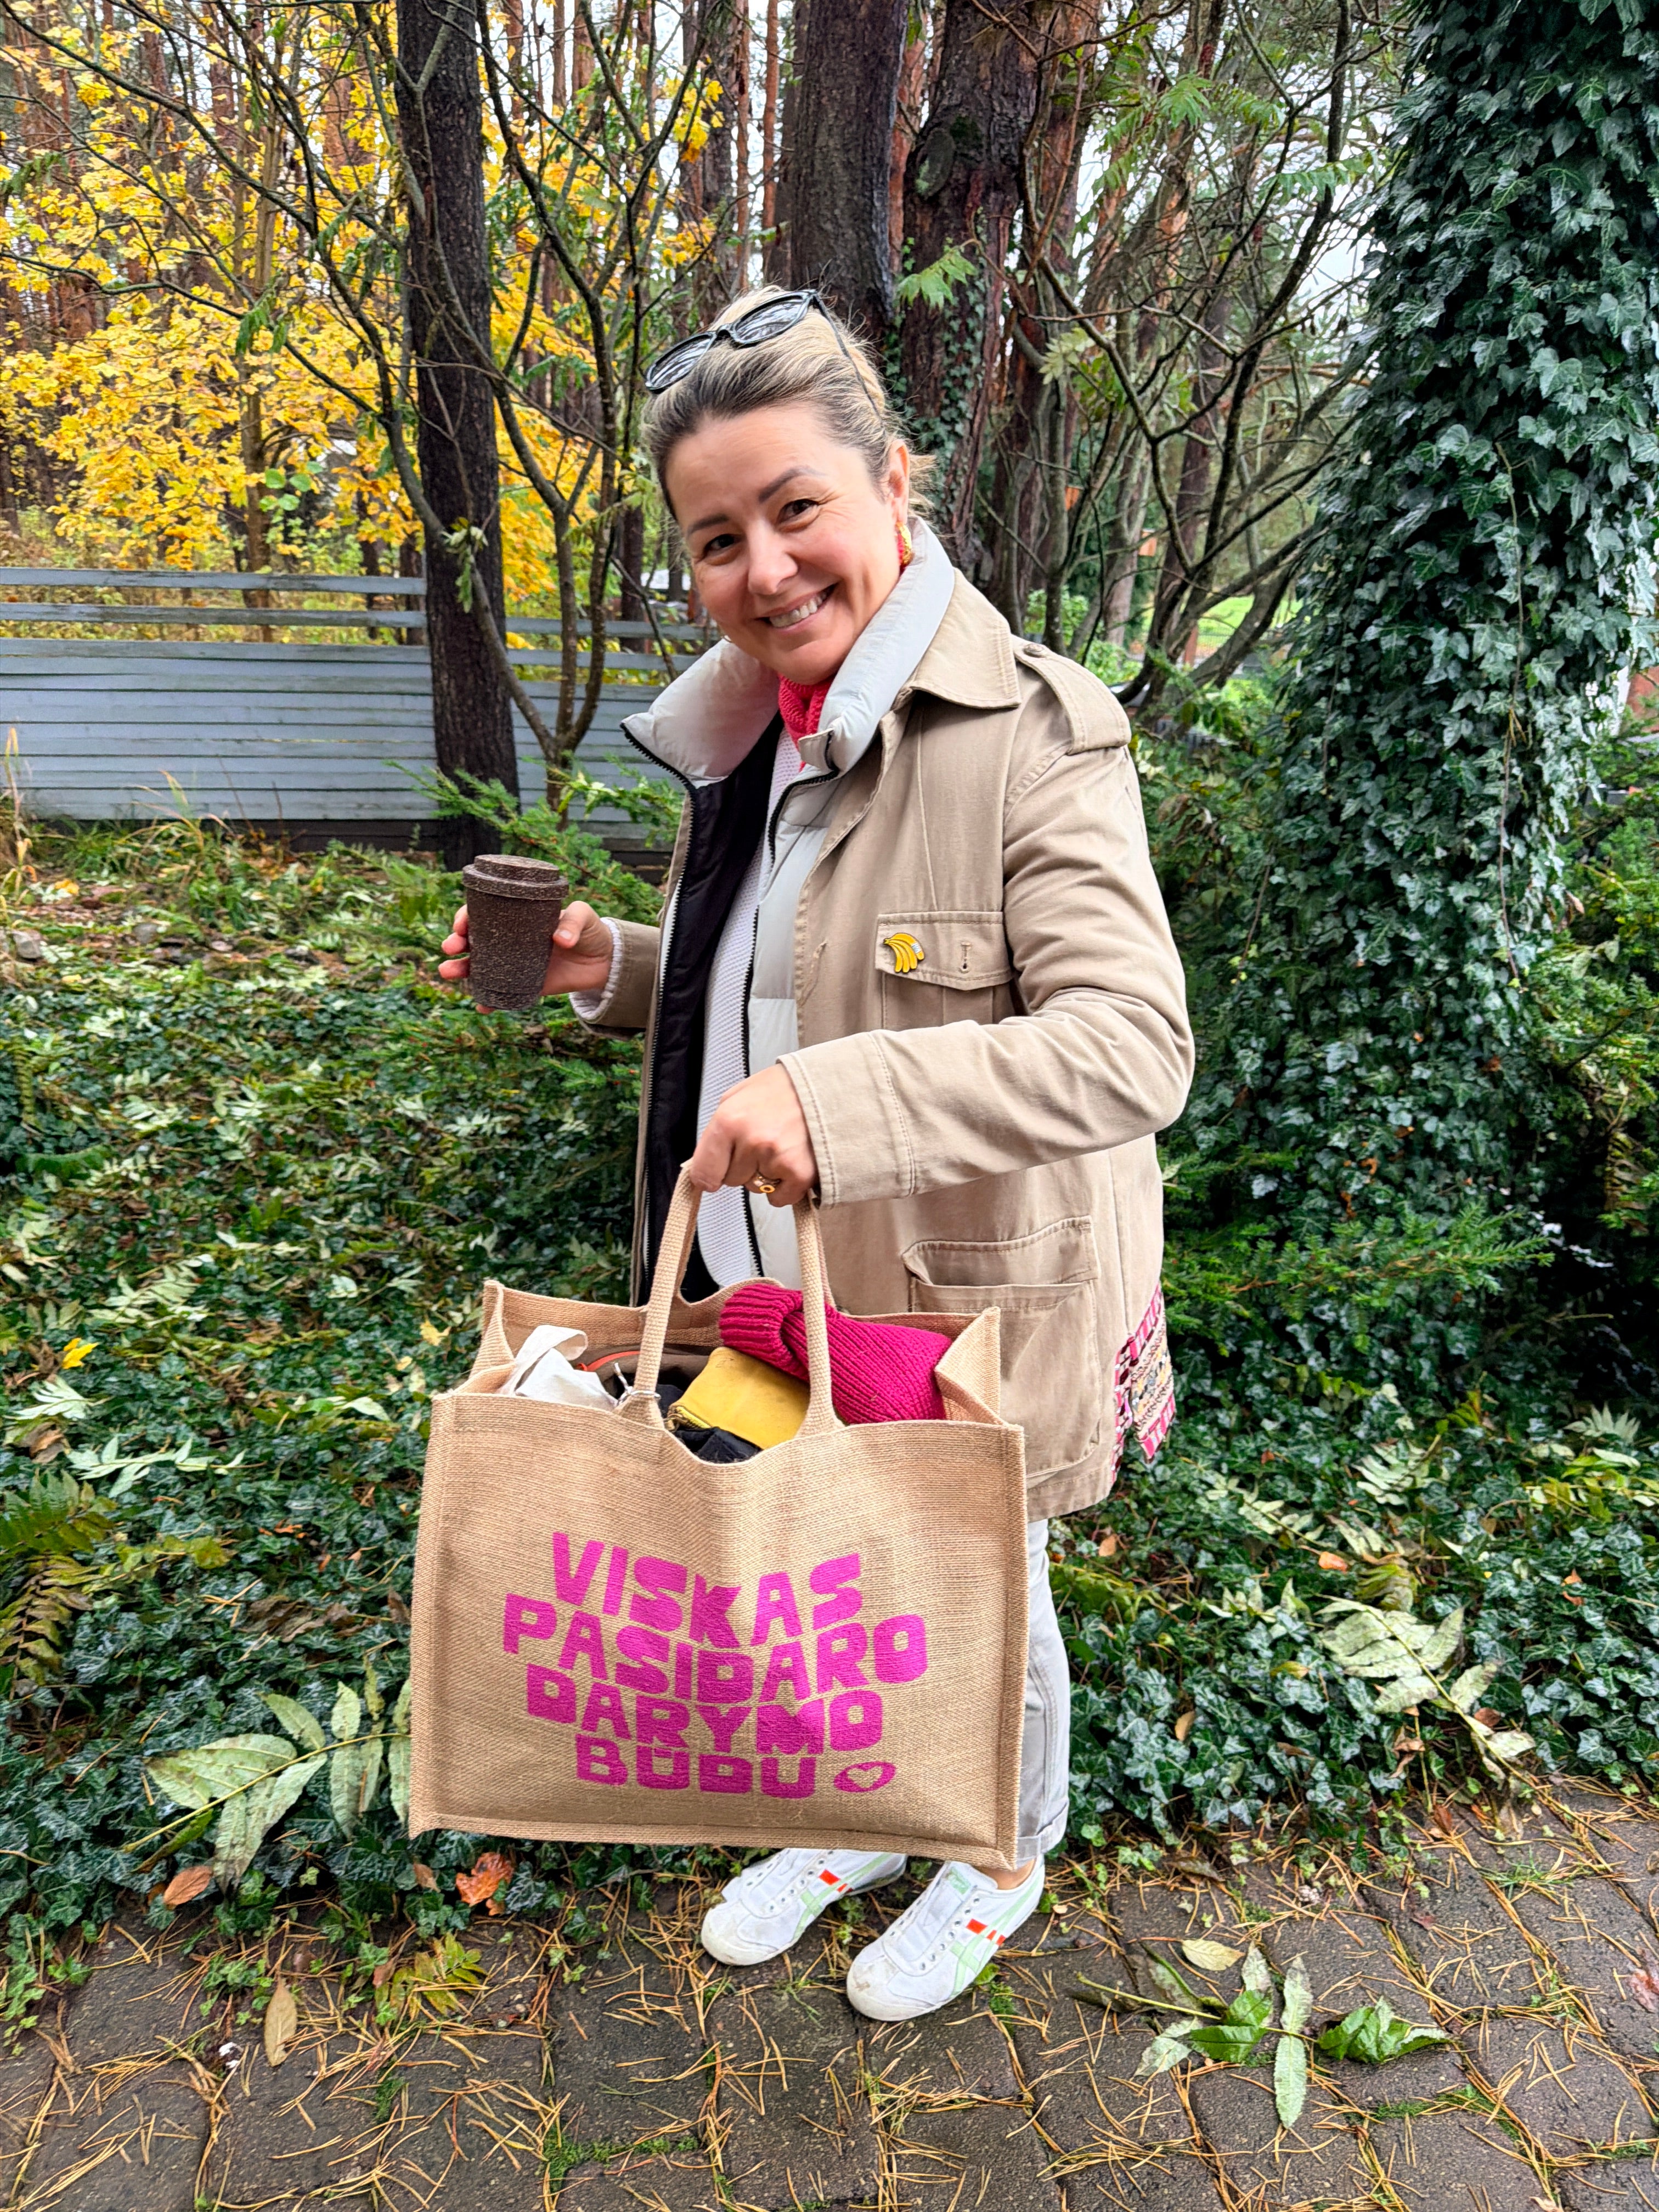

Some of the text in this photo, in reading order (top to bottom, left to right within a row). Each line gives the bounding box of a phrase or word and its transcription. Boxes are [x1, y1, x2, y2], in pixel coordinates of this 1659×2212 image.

[552, 1532, 863, 1649] VISKAS
[503, 1592, 928, 1704] PASIDARO
[526, 1663, 883, 1756] DARYMO
